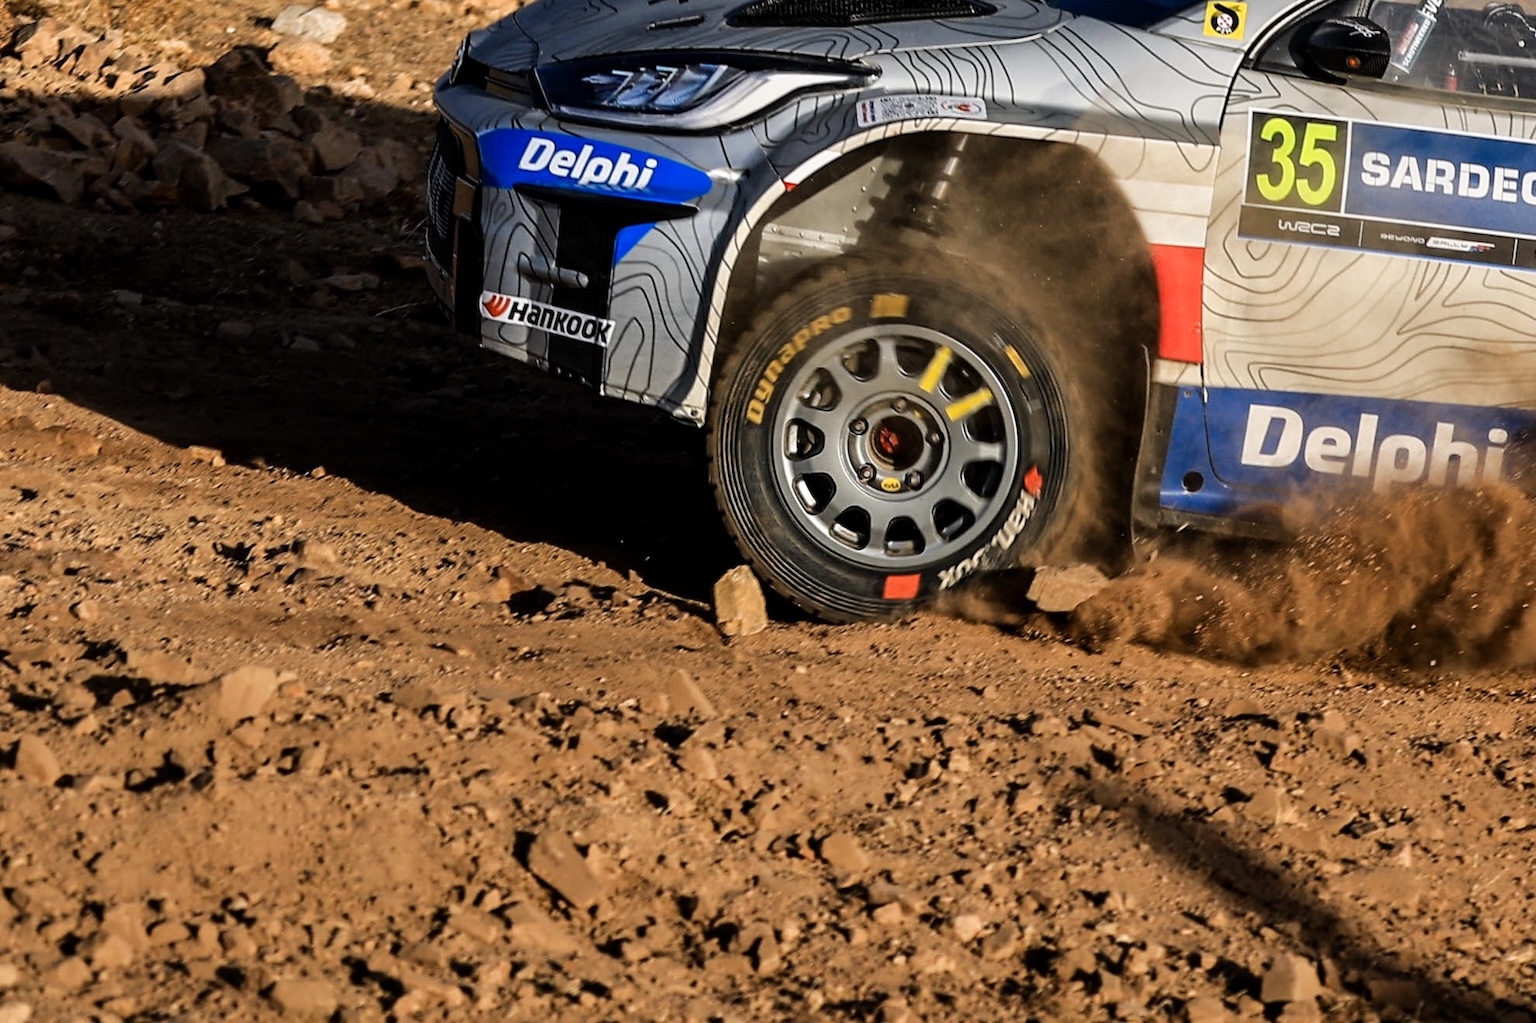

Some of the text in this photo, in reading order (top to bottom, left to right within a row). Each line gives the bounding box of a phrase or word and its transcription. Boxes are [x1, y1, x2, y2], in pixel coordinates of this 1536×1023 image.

[518, 136, 658, 190] Delphi
[1256, 117, 1337, 206] 35
[1278, 219, 1341, 238] WRC2
[1380, 233, 1425, 245] BEYOND
[1240, 403, 1509, 494] Delphi
